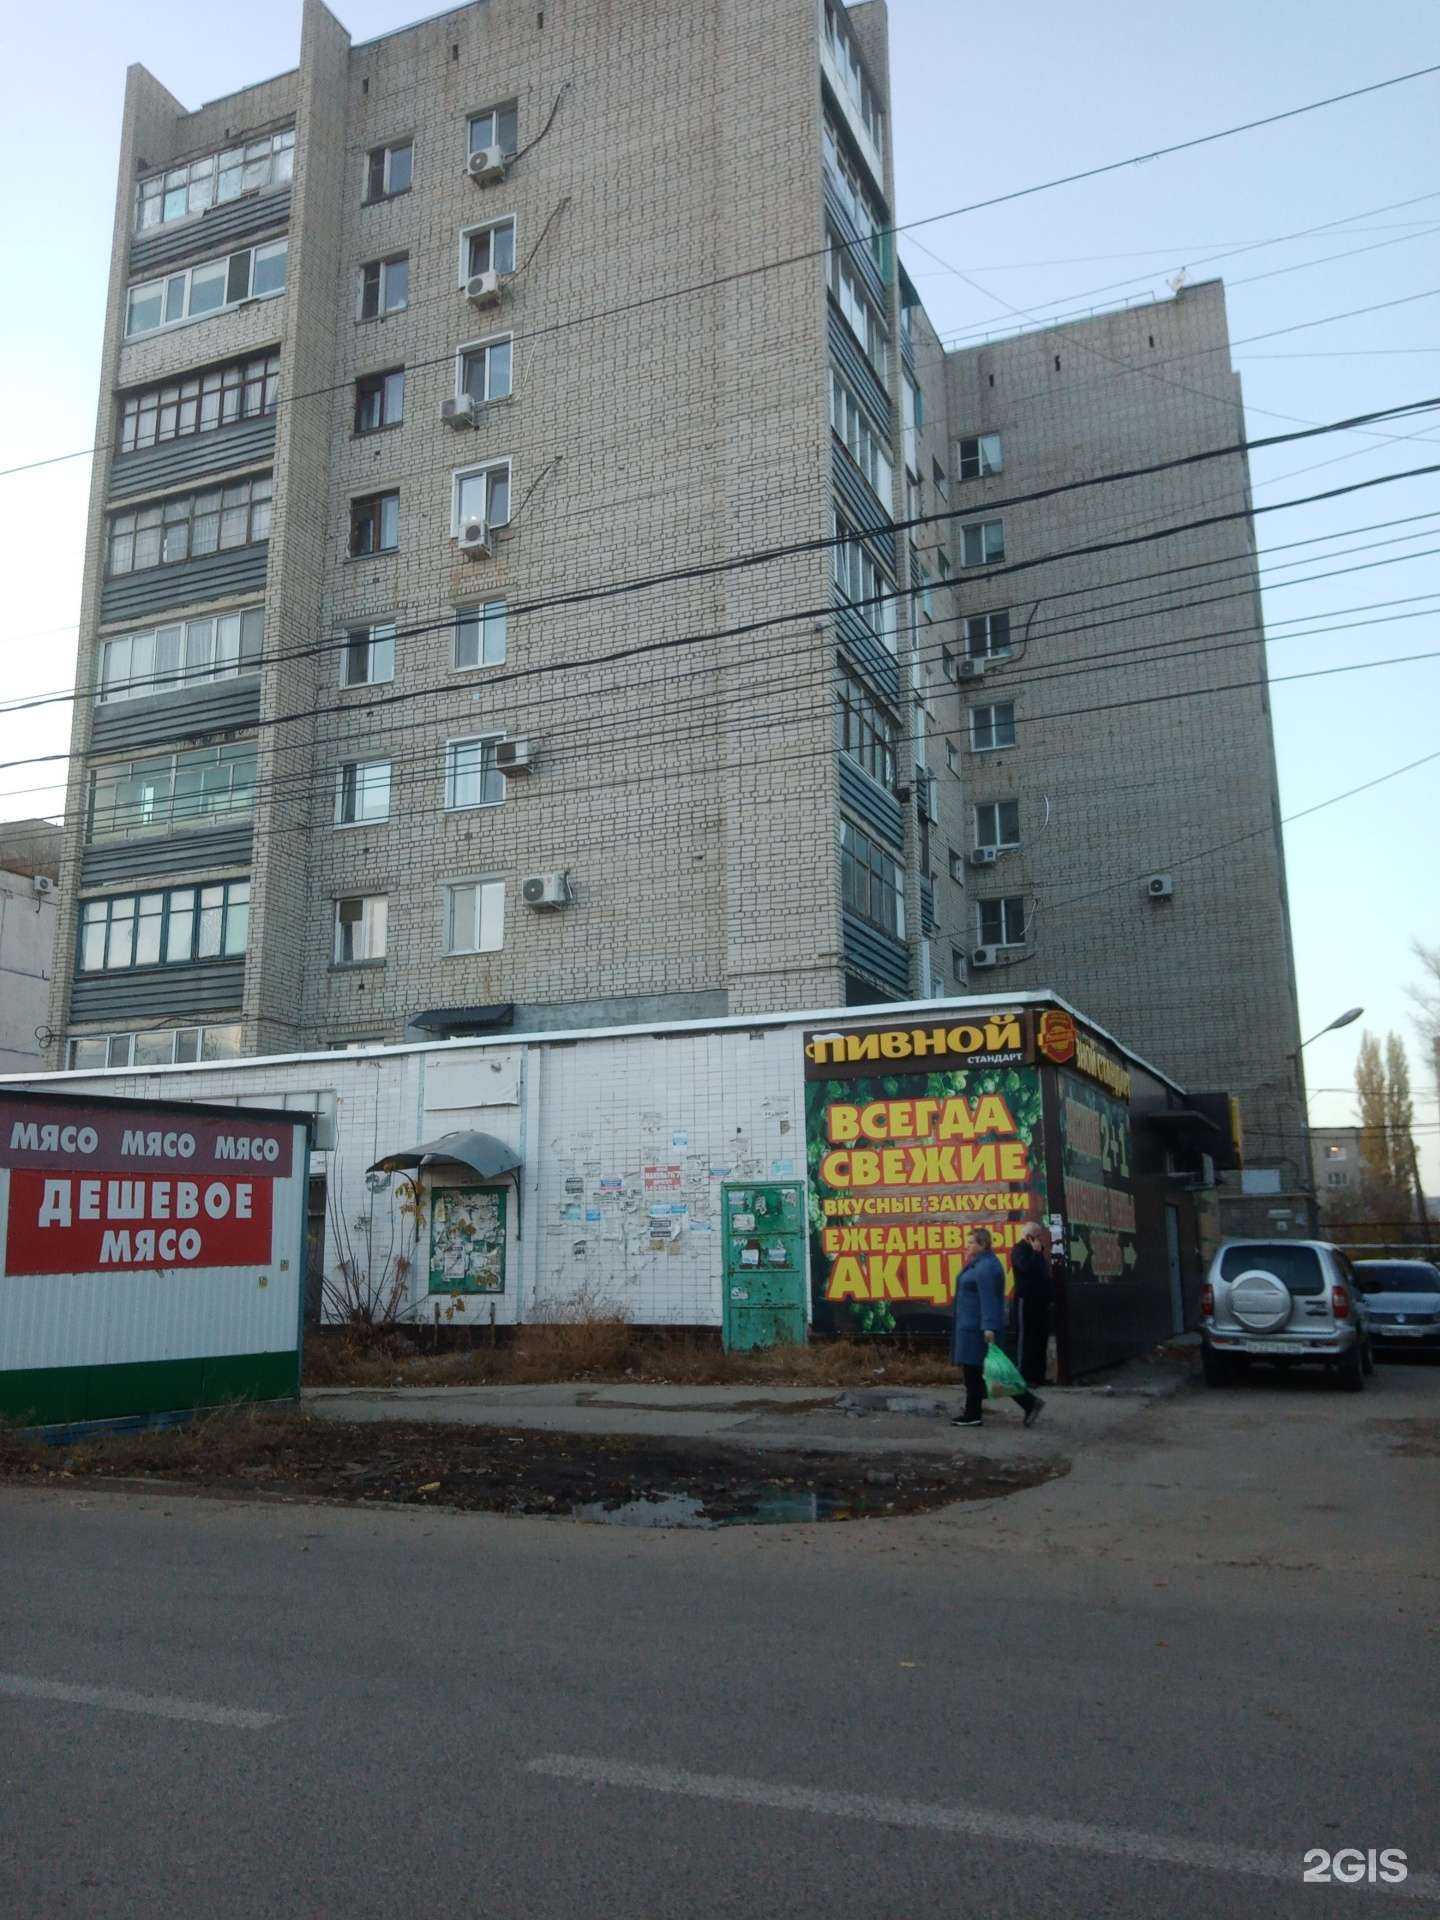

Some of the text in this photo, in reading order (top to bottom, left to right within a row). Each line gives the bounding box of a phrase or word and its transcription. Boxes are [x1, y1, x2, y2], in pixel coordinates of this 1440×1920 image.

[805, 1014, 1022, 1064] ПИВНОЙ
[967, 1052, 1023, 1065] СТАНДАРТ
[831, 1097, 1015, 1141] ВСЕГДА
[9, 1122, 280, 1162] МЯСО МЯСО МЯСО
[823, 1144, 1028, 1185] СВЕЖИЕ
[38, 1179, 253, 1228] ДЕШЕВОЕ
[824, 1193, 1029, 1216] ВКУСНЫЕ ЗАКУСКИ
[99, 1228, 202, 1263] МЯСО
